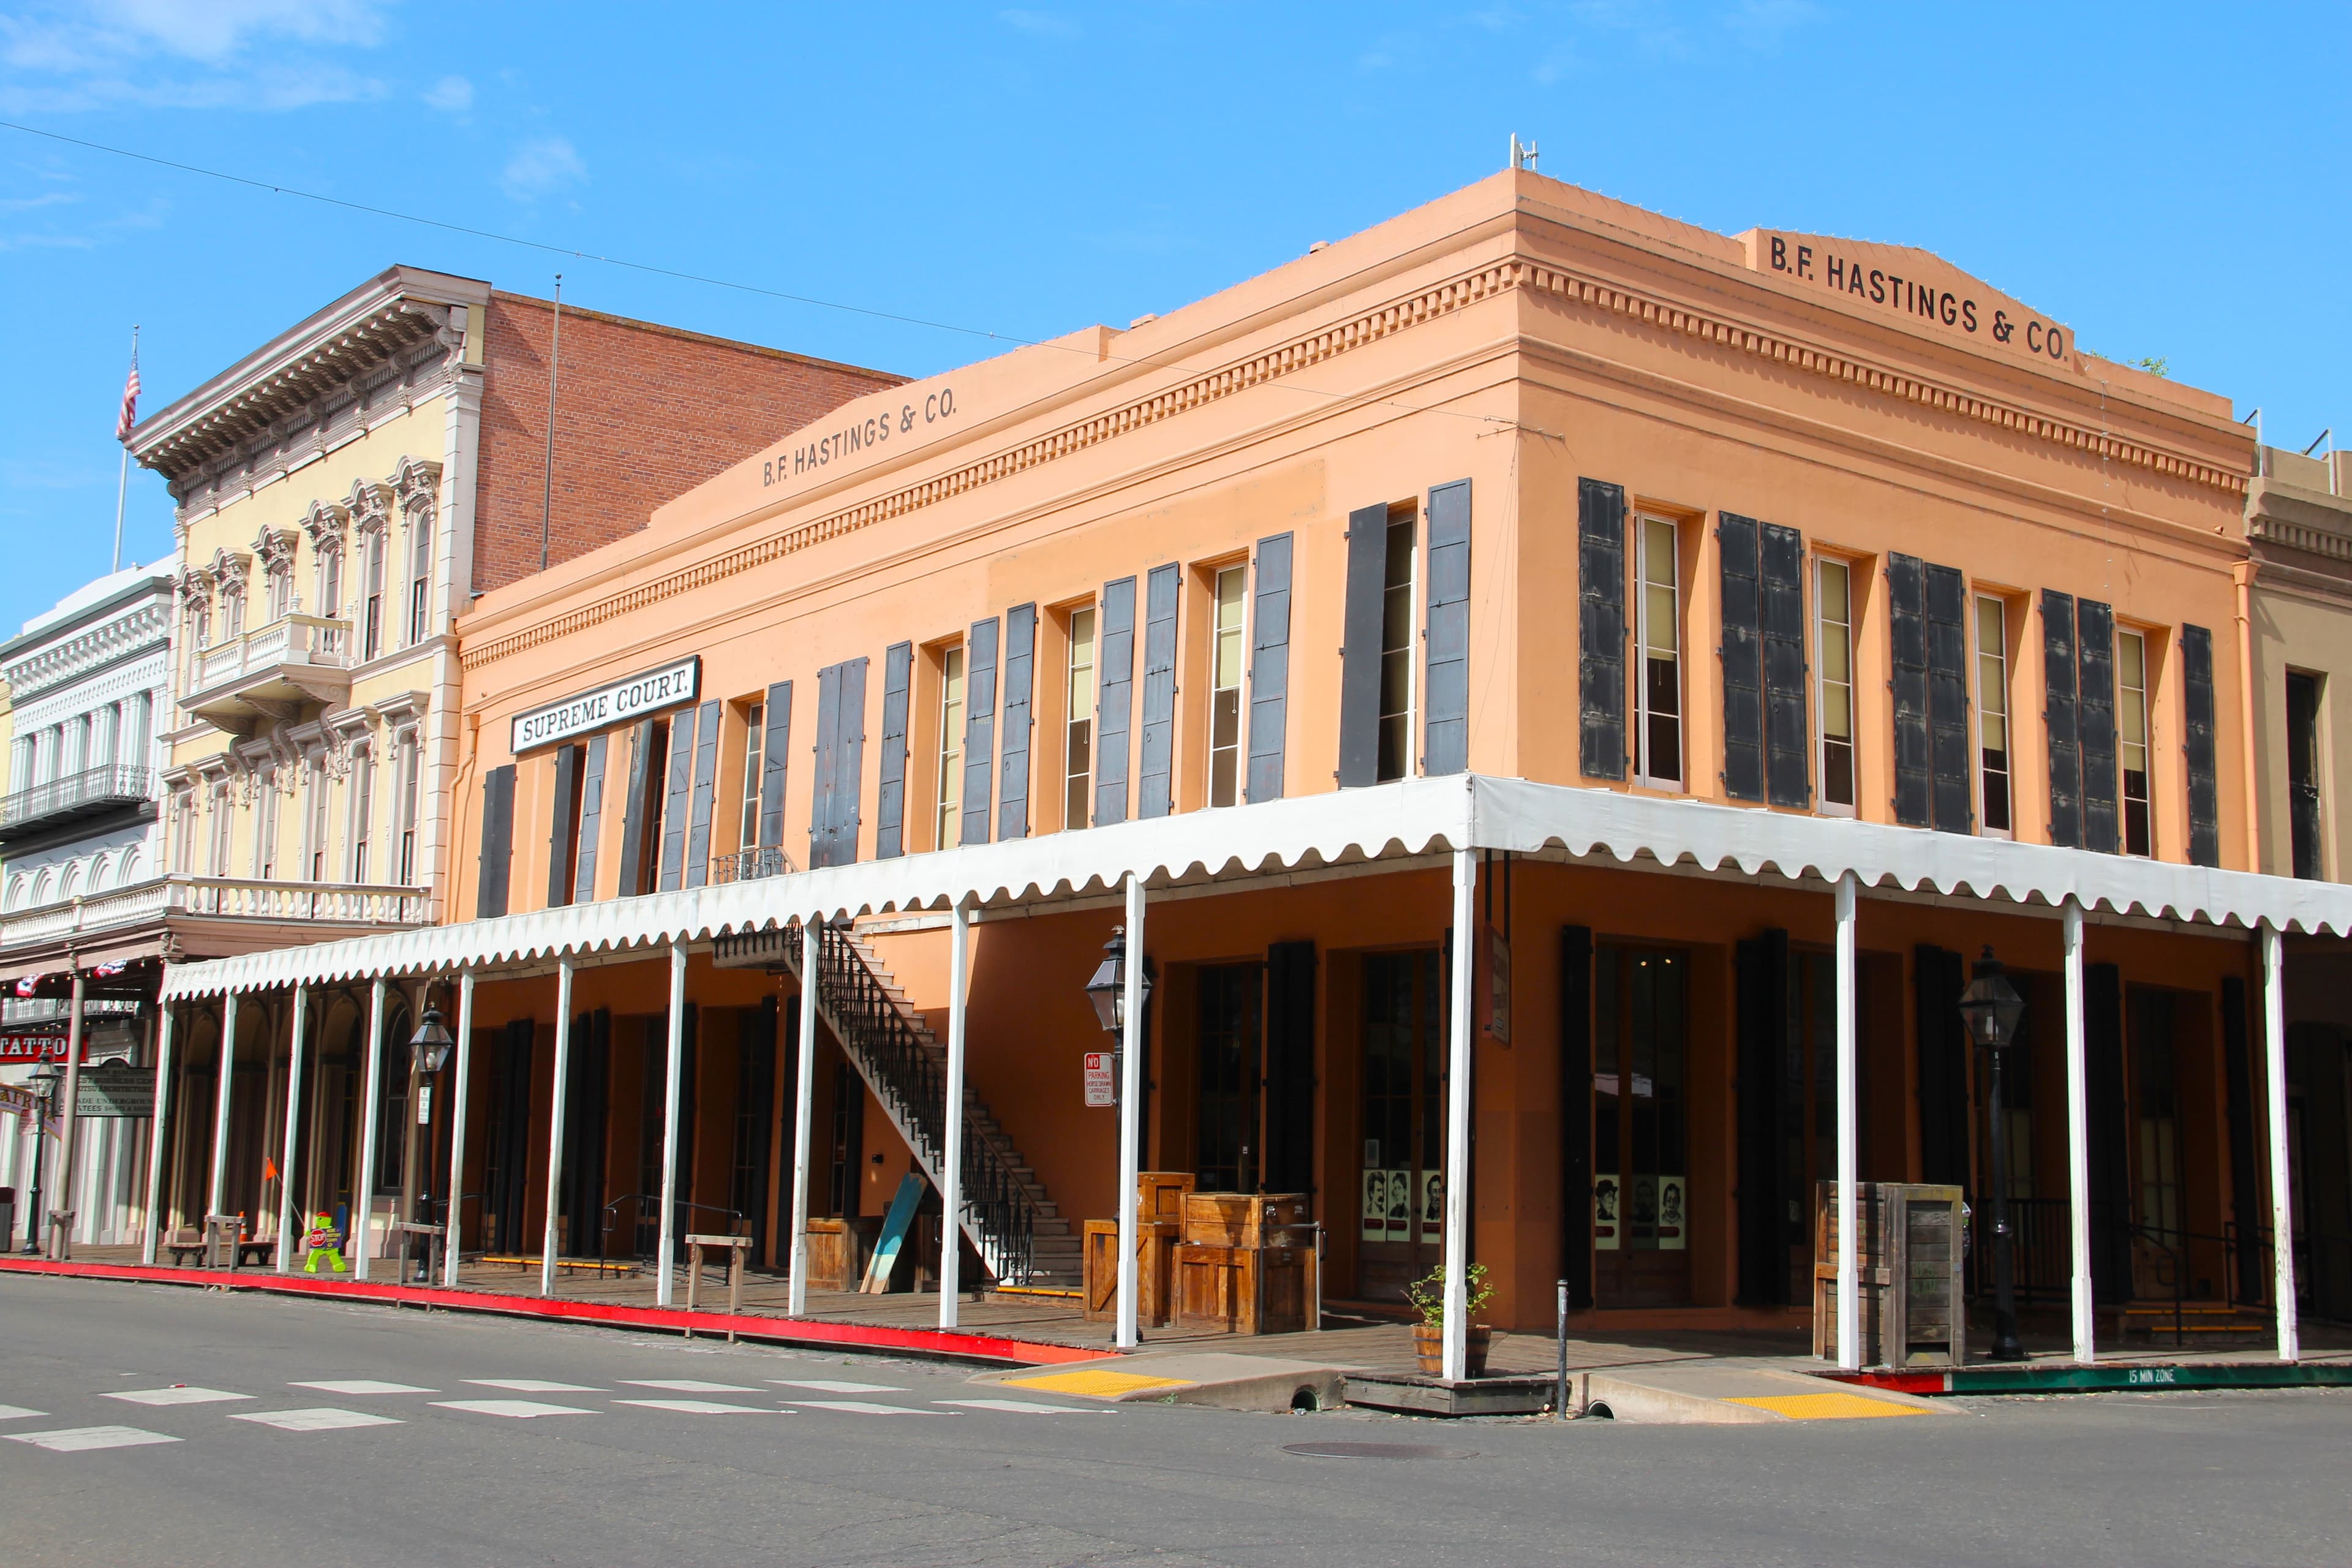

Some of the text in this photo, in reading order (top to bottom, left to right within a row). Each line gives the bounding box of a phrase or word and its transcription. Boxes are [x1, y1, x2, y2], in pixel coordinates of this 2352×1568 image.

[1771, 236, 2068, 362] B.F. HASTINGS & CO.
[764, 388, 957, 487] B.F. HASTINGS & CO.
[523, 669, 687, 742] SUPREME COURT.
[0, 1038, 67, 1055] TATTO
[1088, 1058, 1099, 1068] NO
[310, 1233, 325, 1243] STOP
[2129, 1368, 2175, 1383] 15 MIN ZONE
